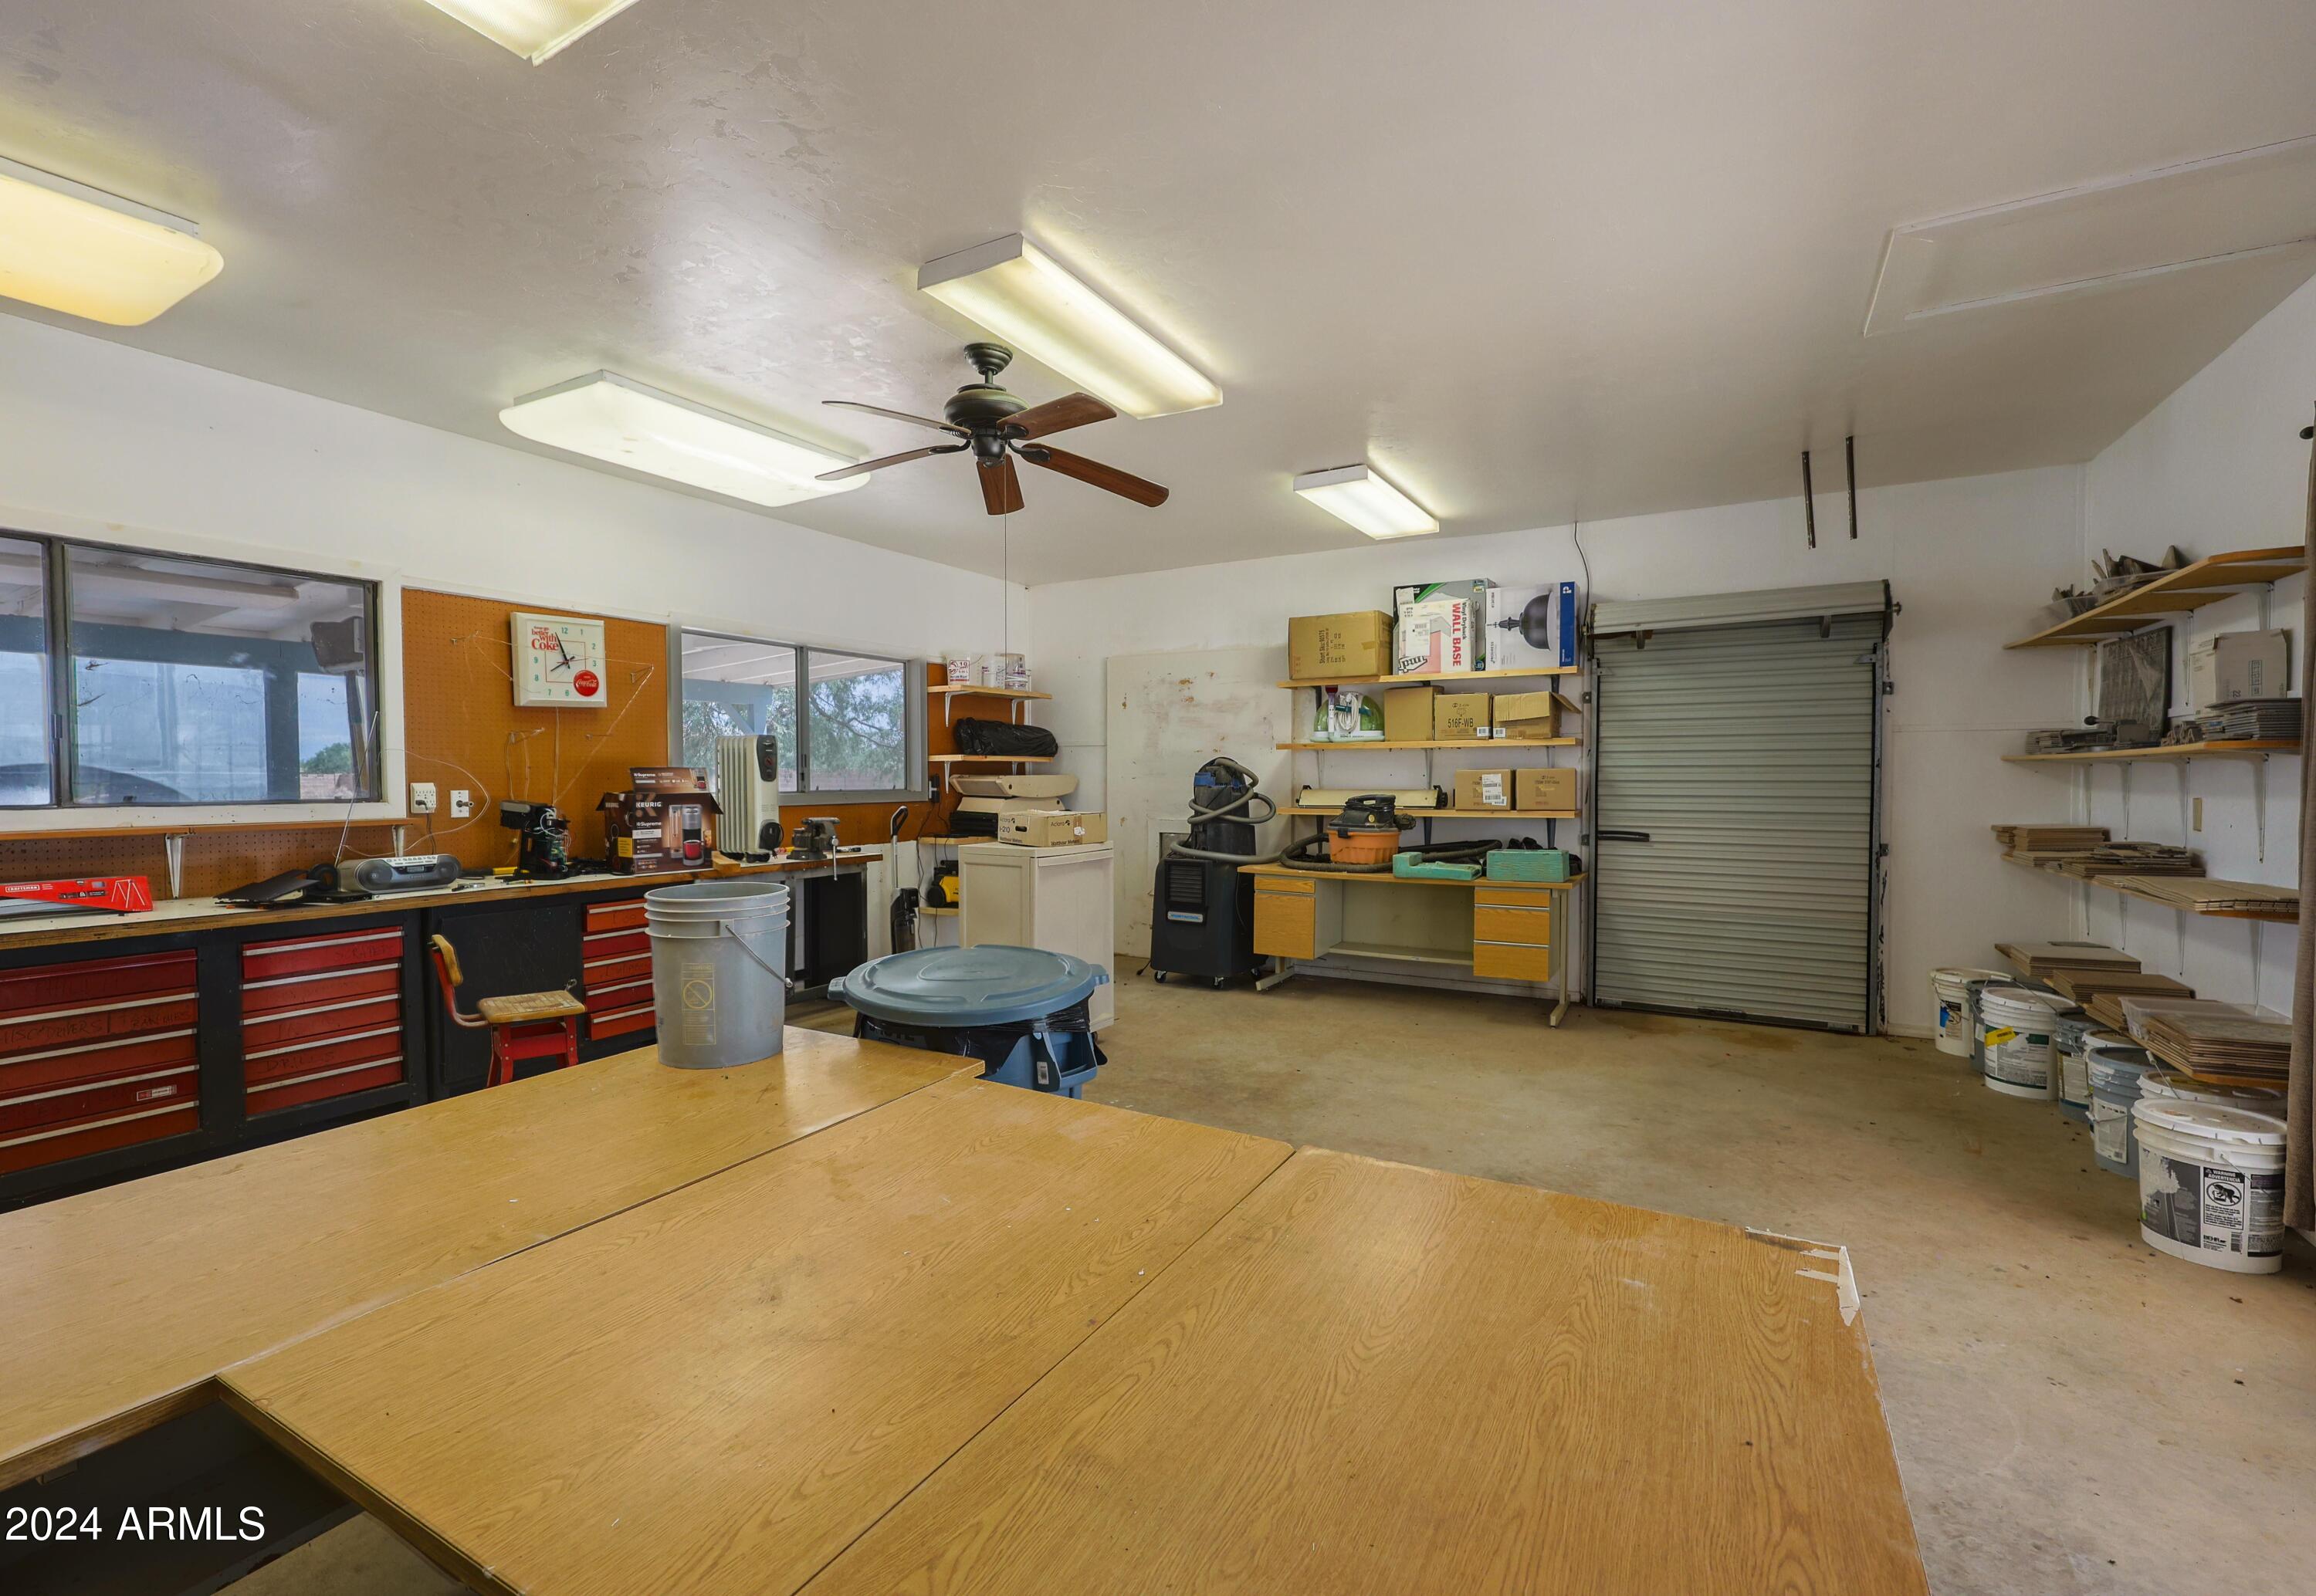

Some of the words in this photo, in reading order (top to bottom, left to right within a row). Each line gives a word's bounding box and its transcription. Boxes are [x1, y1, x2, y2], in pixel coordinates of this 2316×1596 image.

[1452, 603, 1461, 634] WALL
[540, 634, 557, 642] with
[531, 638, 559, 651] Coke
[1452, 637, 1461, 666] BASE
[1448, 718, 1474, 729] 516F-WB
[2208, 1174, 2240, 1182] ADVERTENCIA
